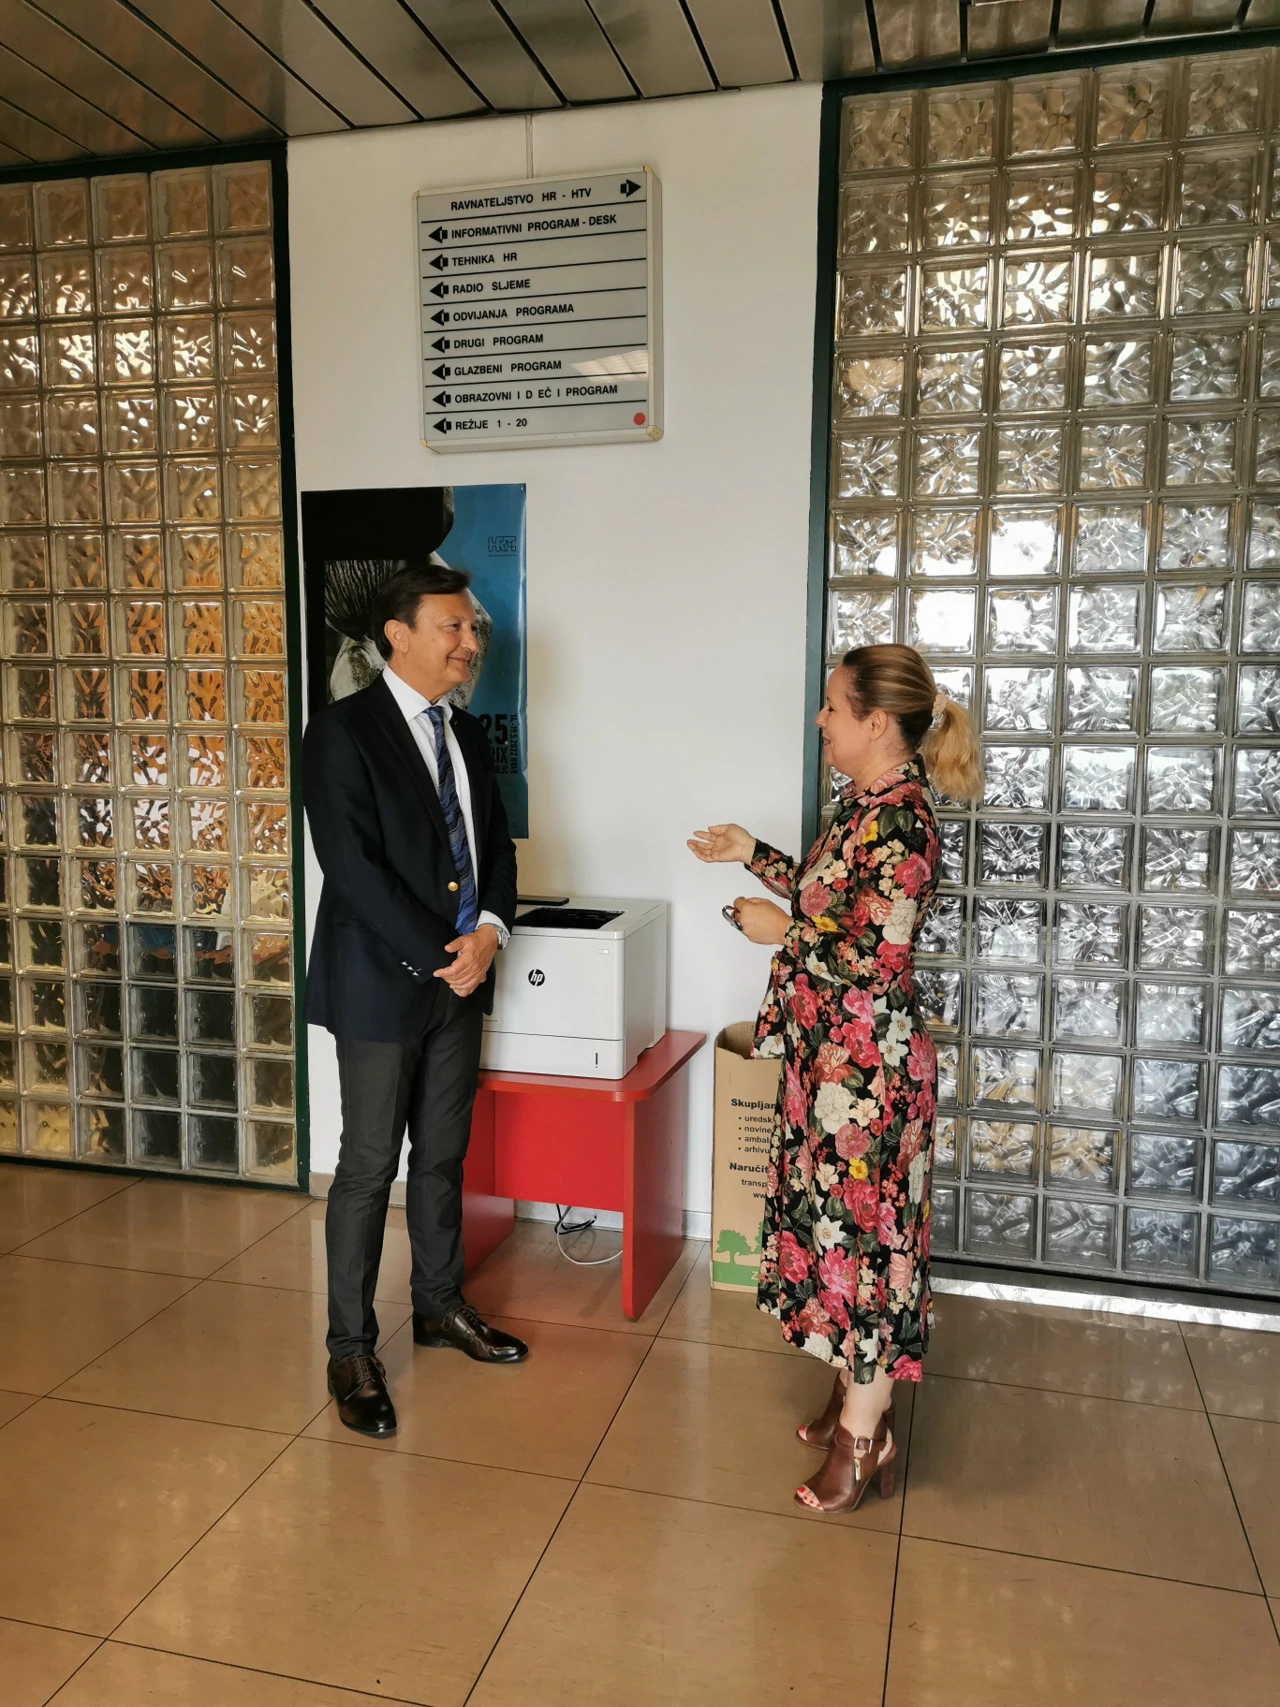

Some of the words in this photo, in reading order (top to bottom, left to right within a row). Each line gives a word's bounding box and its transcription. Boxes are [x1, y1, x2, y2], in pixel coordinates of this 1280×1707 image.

[450, 194, 534, 211] RAVNATELJSTVO
[542, 192, 556, 202] HR
[571, 188, 592, 199] HTV
[452, 223, 522, 239] INFORMATIVNI
[527, 218, 580, 232] PROGRAM
[589, 214, 617, 226] DESK
[452, 254, 495, 266] TEHNIKA
[503, 252, 517, 262] HR
[452, 282, 484, 294] RADIO
[492, 279, 530, 291] SLJEME
[453, 309, 508, 321] ODVIJANJA
[516, 303, 574, 316] PROGRAMA
[454, 338, 485, 348] DRUGI
[493, 334, 544, 346] PROGRAM
[454, 364, 502, 376] GLAZBENI
[510, 360, 562, 372] PROGRAM
[455, 391, 511, 403] OBRAZOVNI
[566, 385, 618, 396] PROGRAM
[456, 418, 488, 430] REŽIJE
[497, 419, 501, 428] 1
[516, 418, 527, 427] 20
[528, 969, 545, 986] hp
